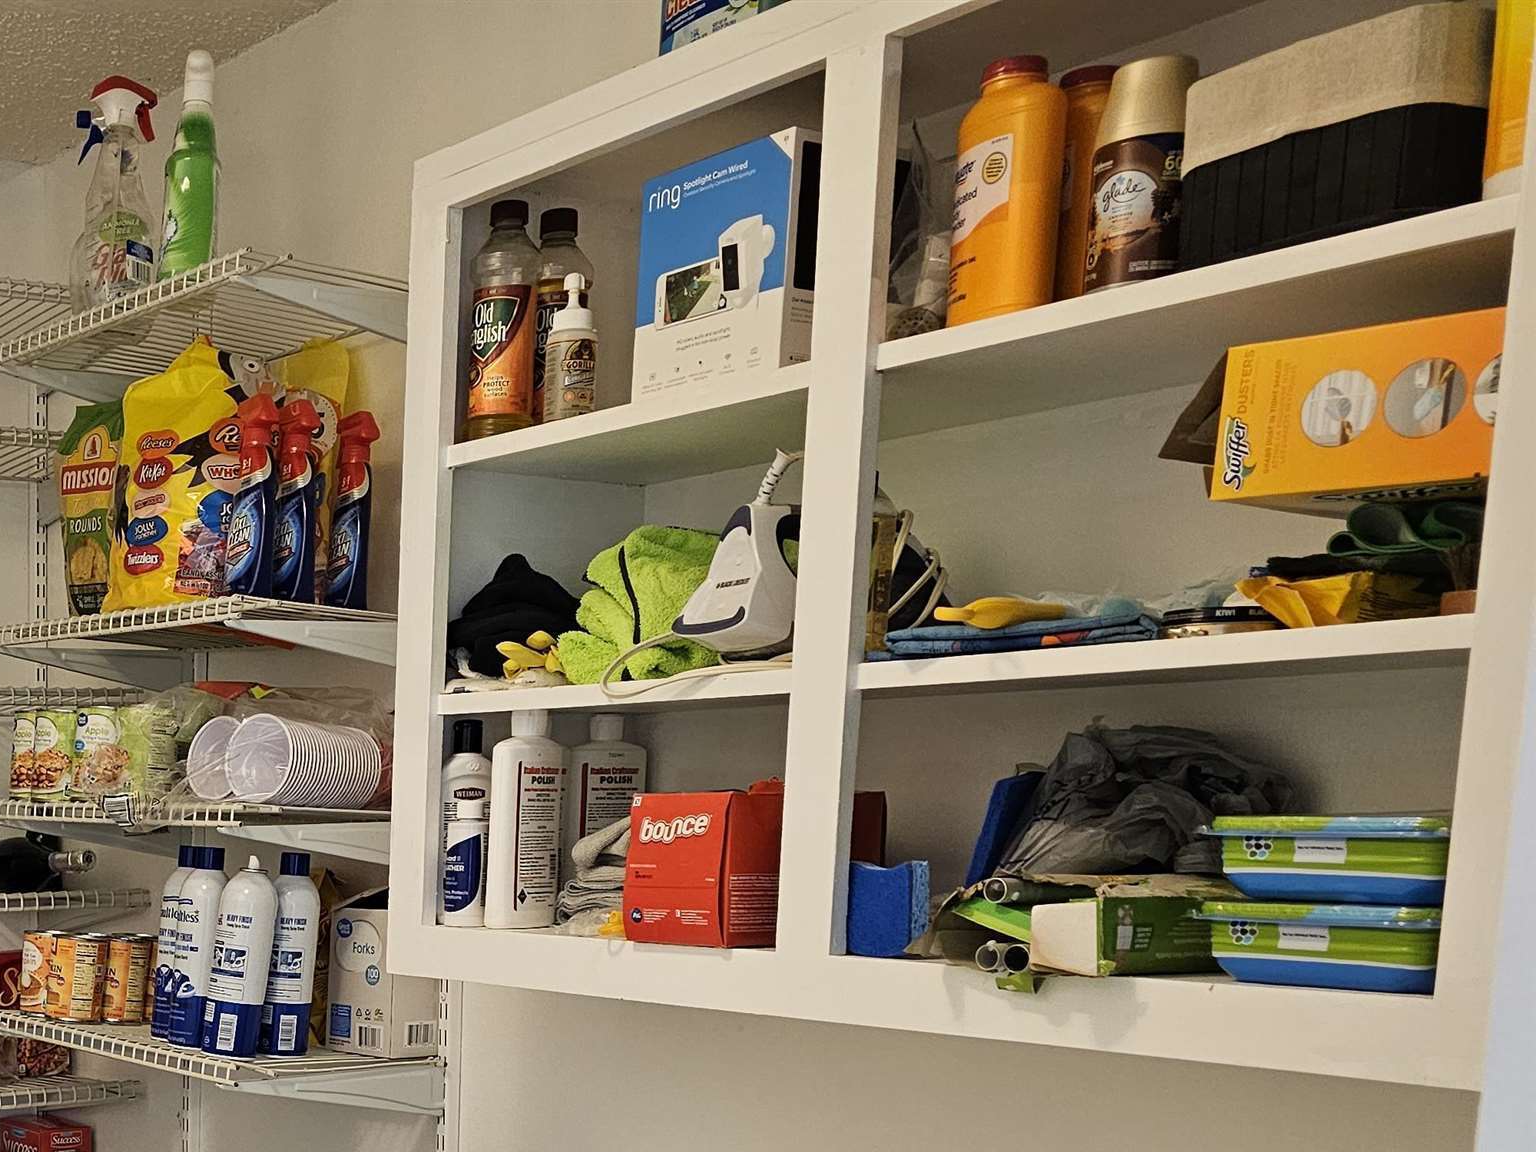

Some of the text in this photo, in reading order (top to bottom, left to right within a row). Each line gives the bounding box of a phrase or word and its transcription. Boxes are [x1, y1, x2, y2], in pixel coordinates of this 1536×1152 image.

[648, 160, 749, 213] ring Spotlight Cam Wired
[1102, 179, 1147, 213] glade
[475, 302, 494, 328] Old
[472, 321, 507, 350] nglish
[1222, 418, 1251, 490] Swiffer
[69, 514, 102, 535] ROUNDS
[133, 521, 155, 537] JOLLY
[127, 552, 160, 566] Twizzlers
[531, 776, 556, 785] POLISH
[599, 776, 633, 784] POLISH
[639, 813, 712, 844] bounce
[352, 941, 376, 956] Forks
[367, 967, 379, 979] 100
